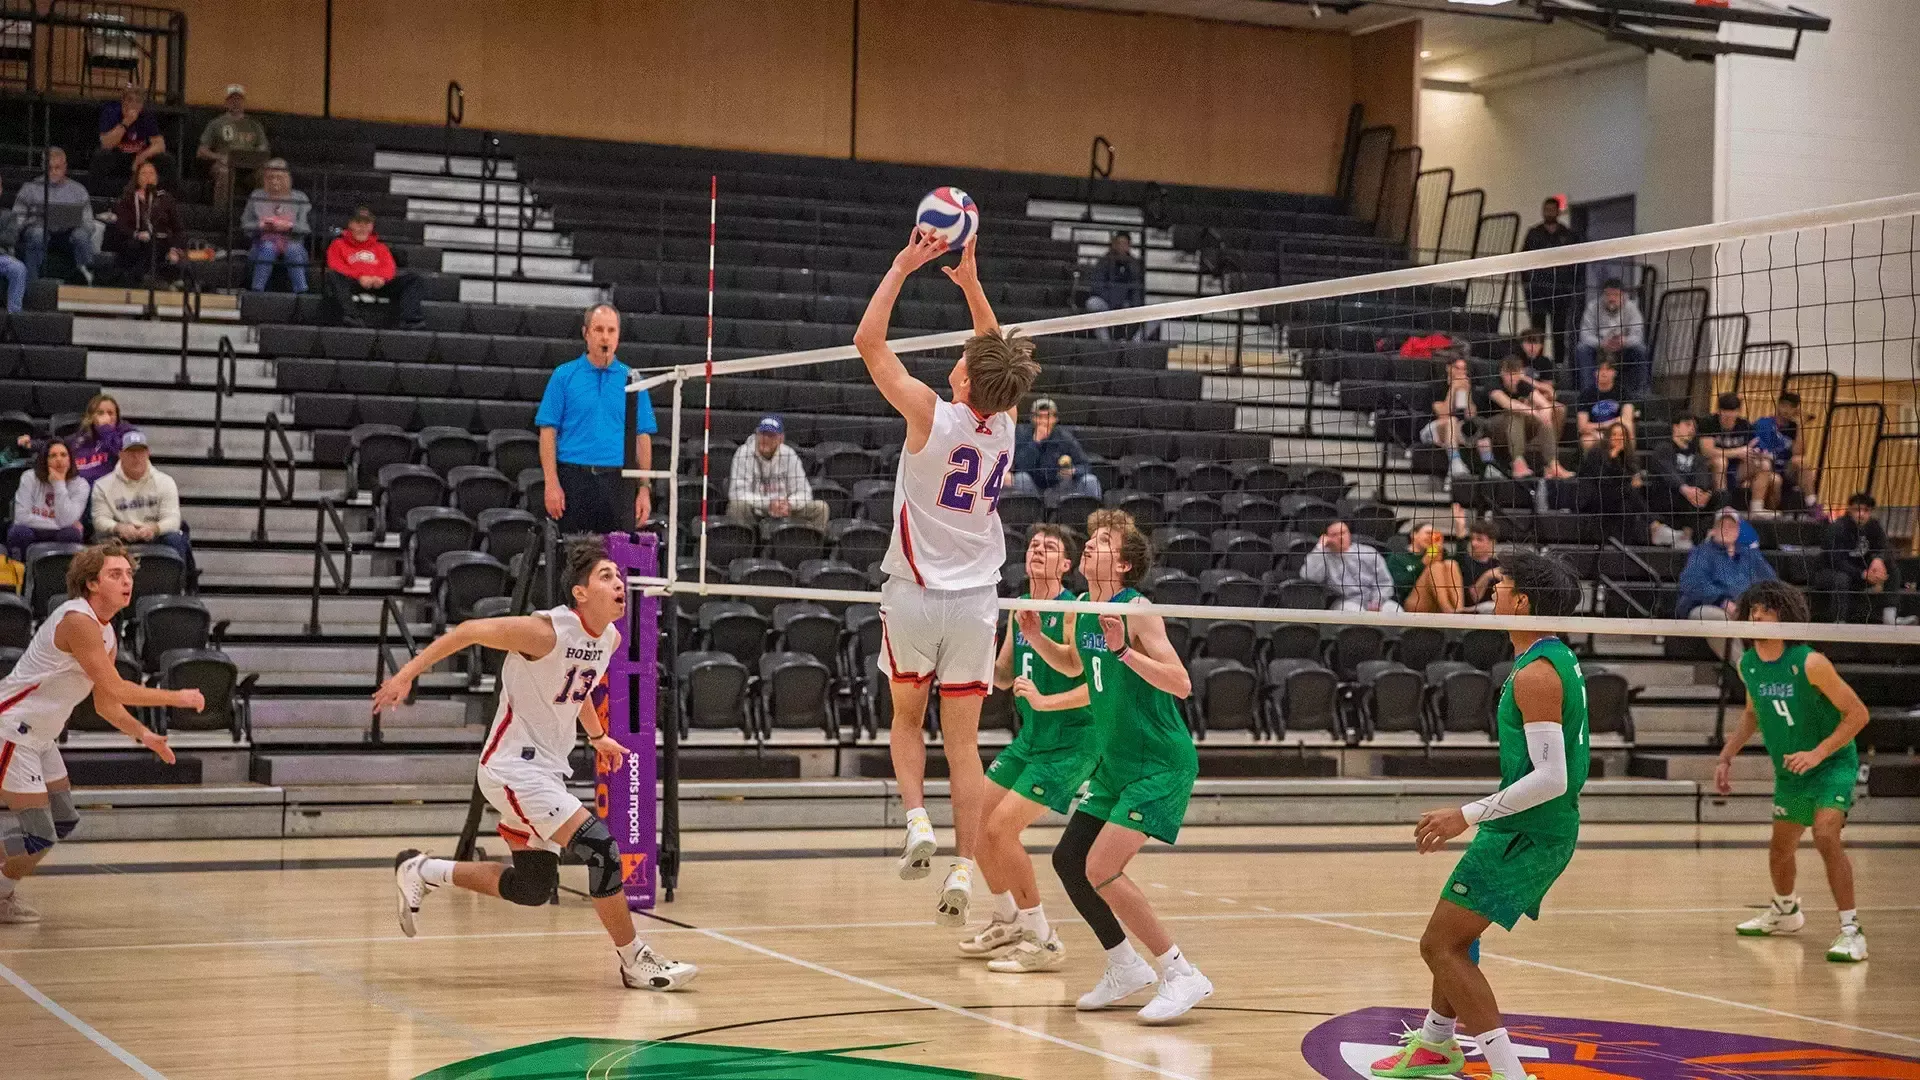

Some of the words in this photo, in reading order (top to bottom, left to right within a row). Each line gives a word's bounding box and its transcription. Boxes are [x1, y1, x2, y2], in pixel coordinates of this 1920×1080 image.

[936, 444, 1010, 516] 24
[565, 647, 603, 661] HOBRT
[553, 664, 597, 705] 13
[1092, 656, 1103, 692] 8
[1772, 699, 1795, 726] 4
